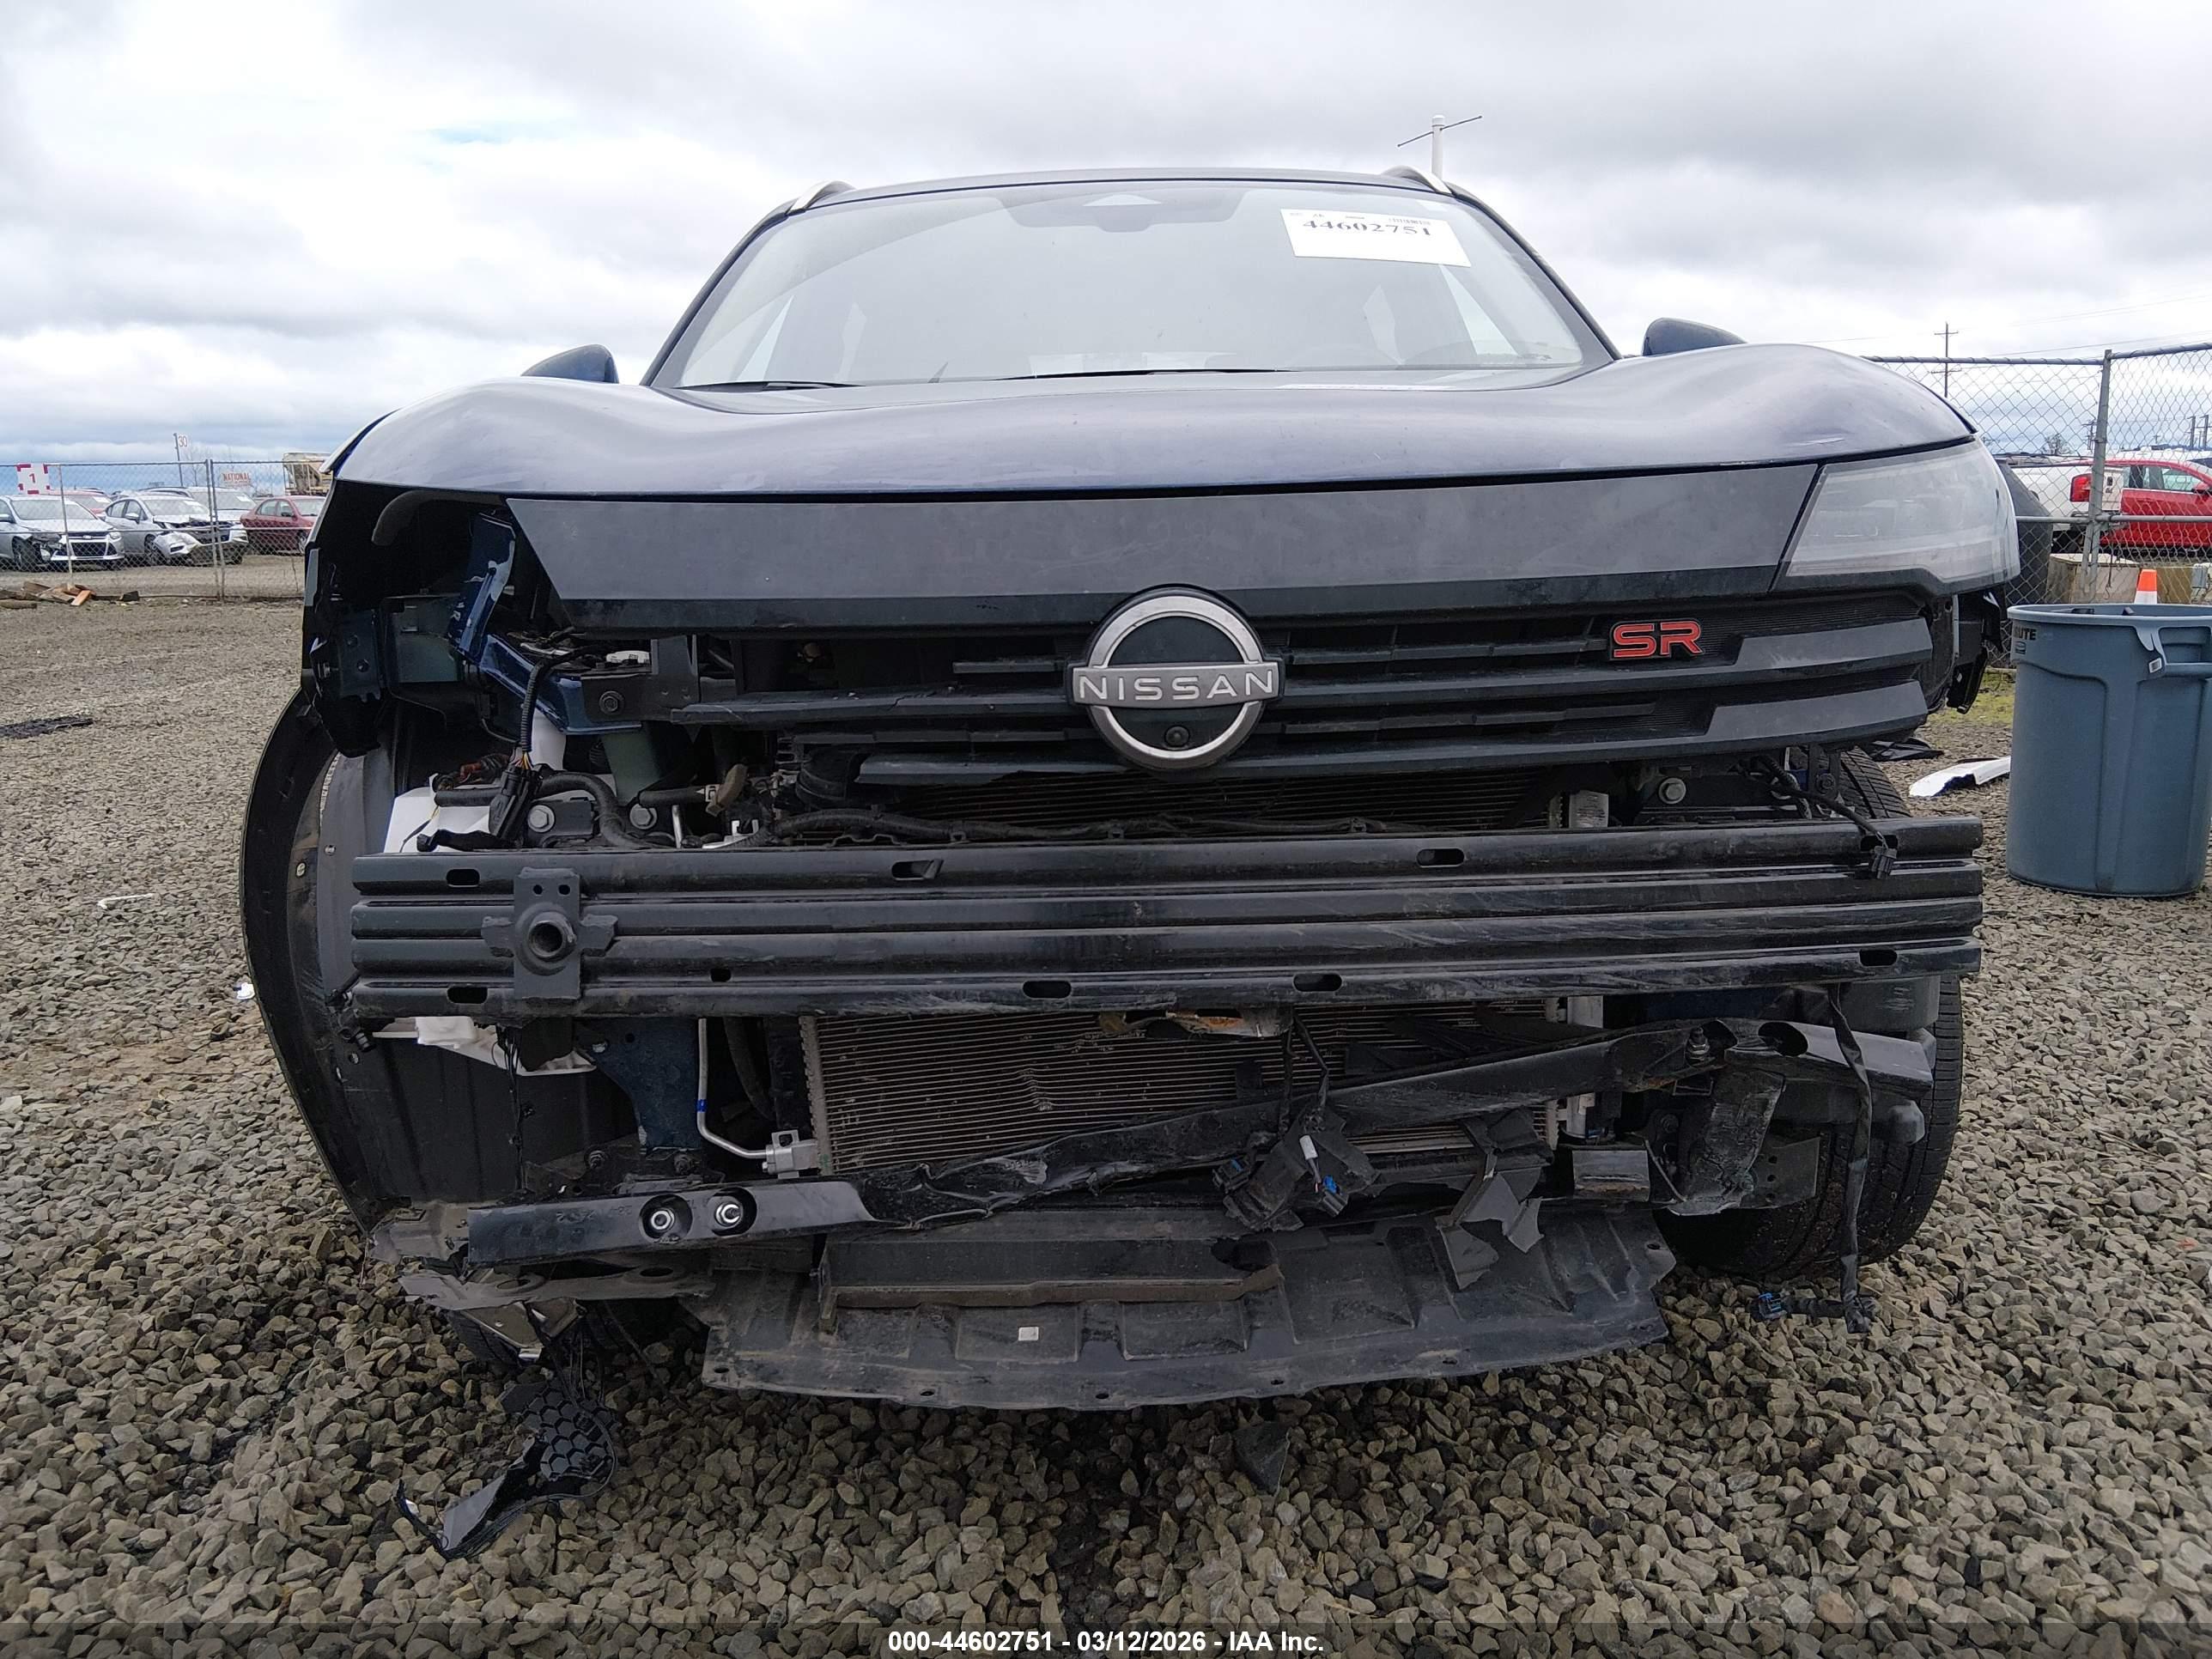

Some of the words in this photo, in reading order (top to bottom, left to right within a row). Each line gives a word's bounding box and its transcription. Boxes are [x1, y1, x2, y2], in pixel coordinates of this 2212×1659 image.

[1303, 220, 1431, 236] 44602751
[178, 435, 188, 447] 30
[222, 472, 252, 482] NATIONAL
[1613, 621, 1703, 658] SR
[1079, 670, 1273, 701] NISSAN
